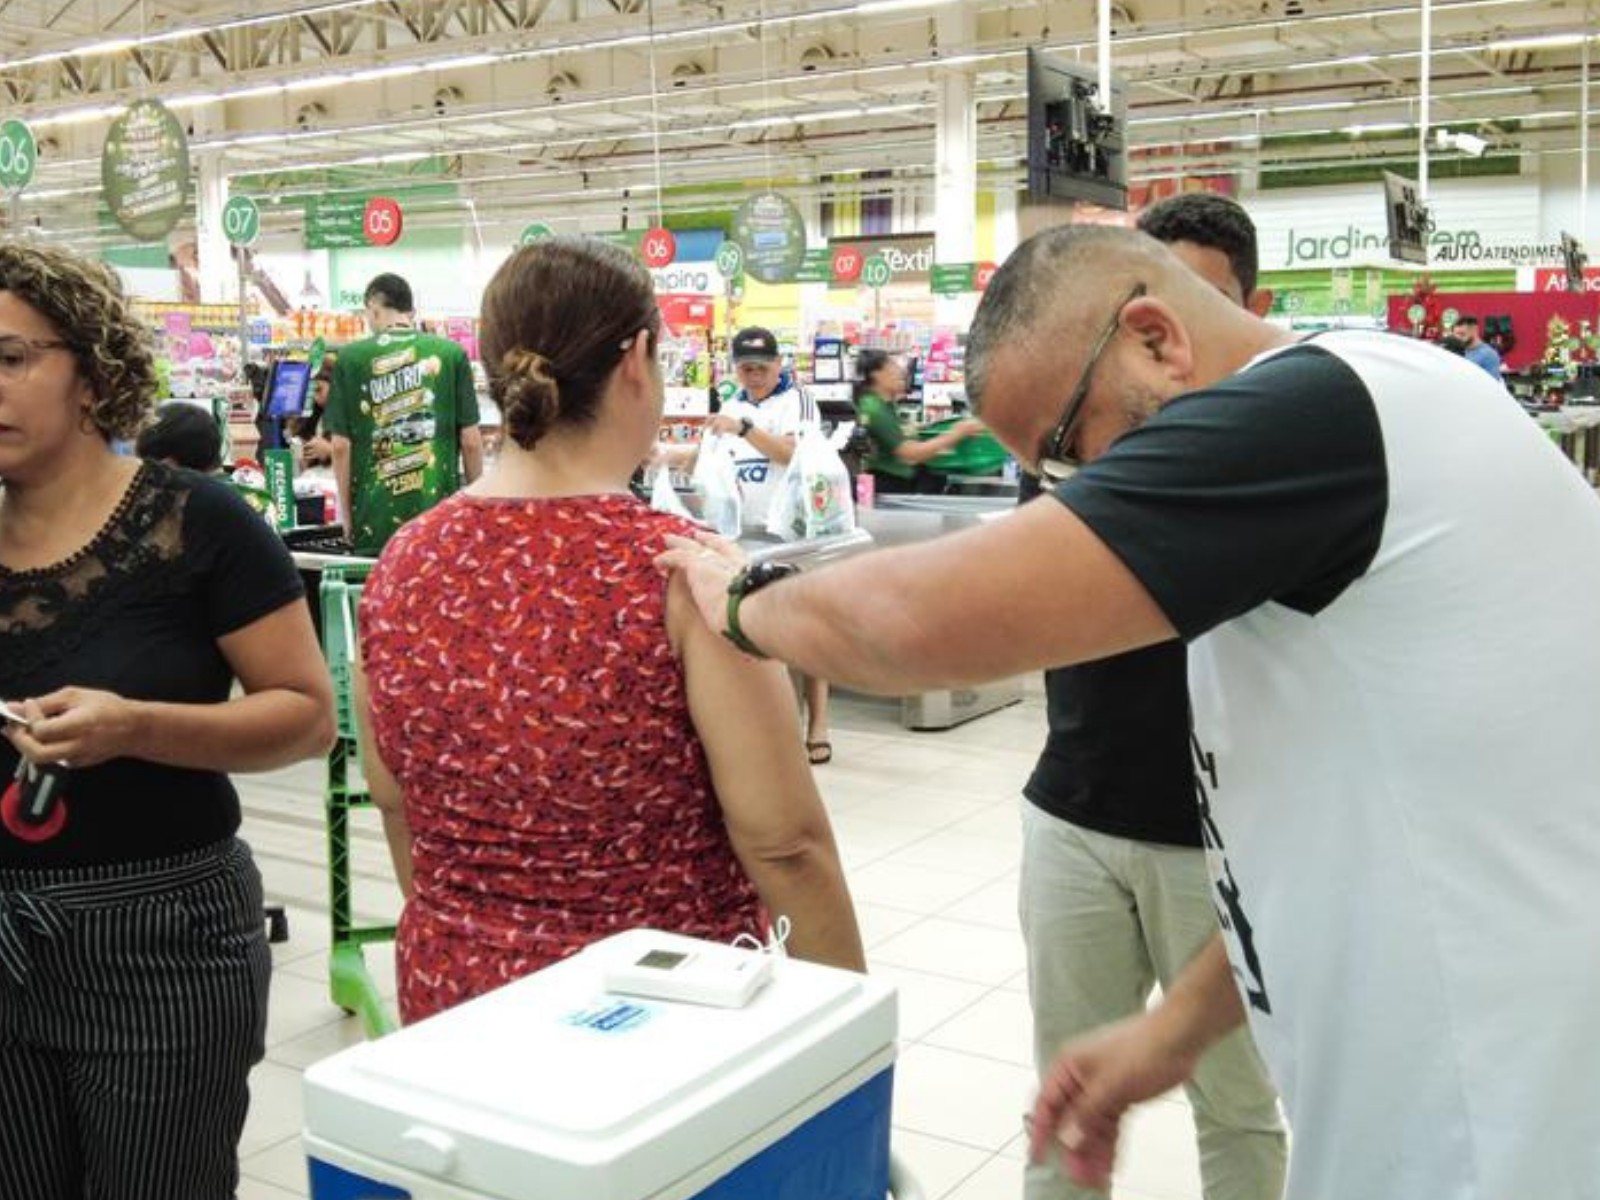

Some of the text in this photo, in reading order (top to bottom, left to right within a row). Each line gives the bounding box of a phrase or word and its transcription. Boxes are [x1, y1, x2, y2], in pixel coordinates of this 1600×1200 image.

[0, 136, 29, 174] 06
[226, 208, 253, 234] 07
[370, 210, 391, 234] 05
[648, 239, 668, 258] 06
[867, 264, 887, 282] 10
